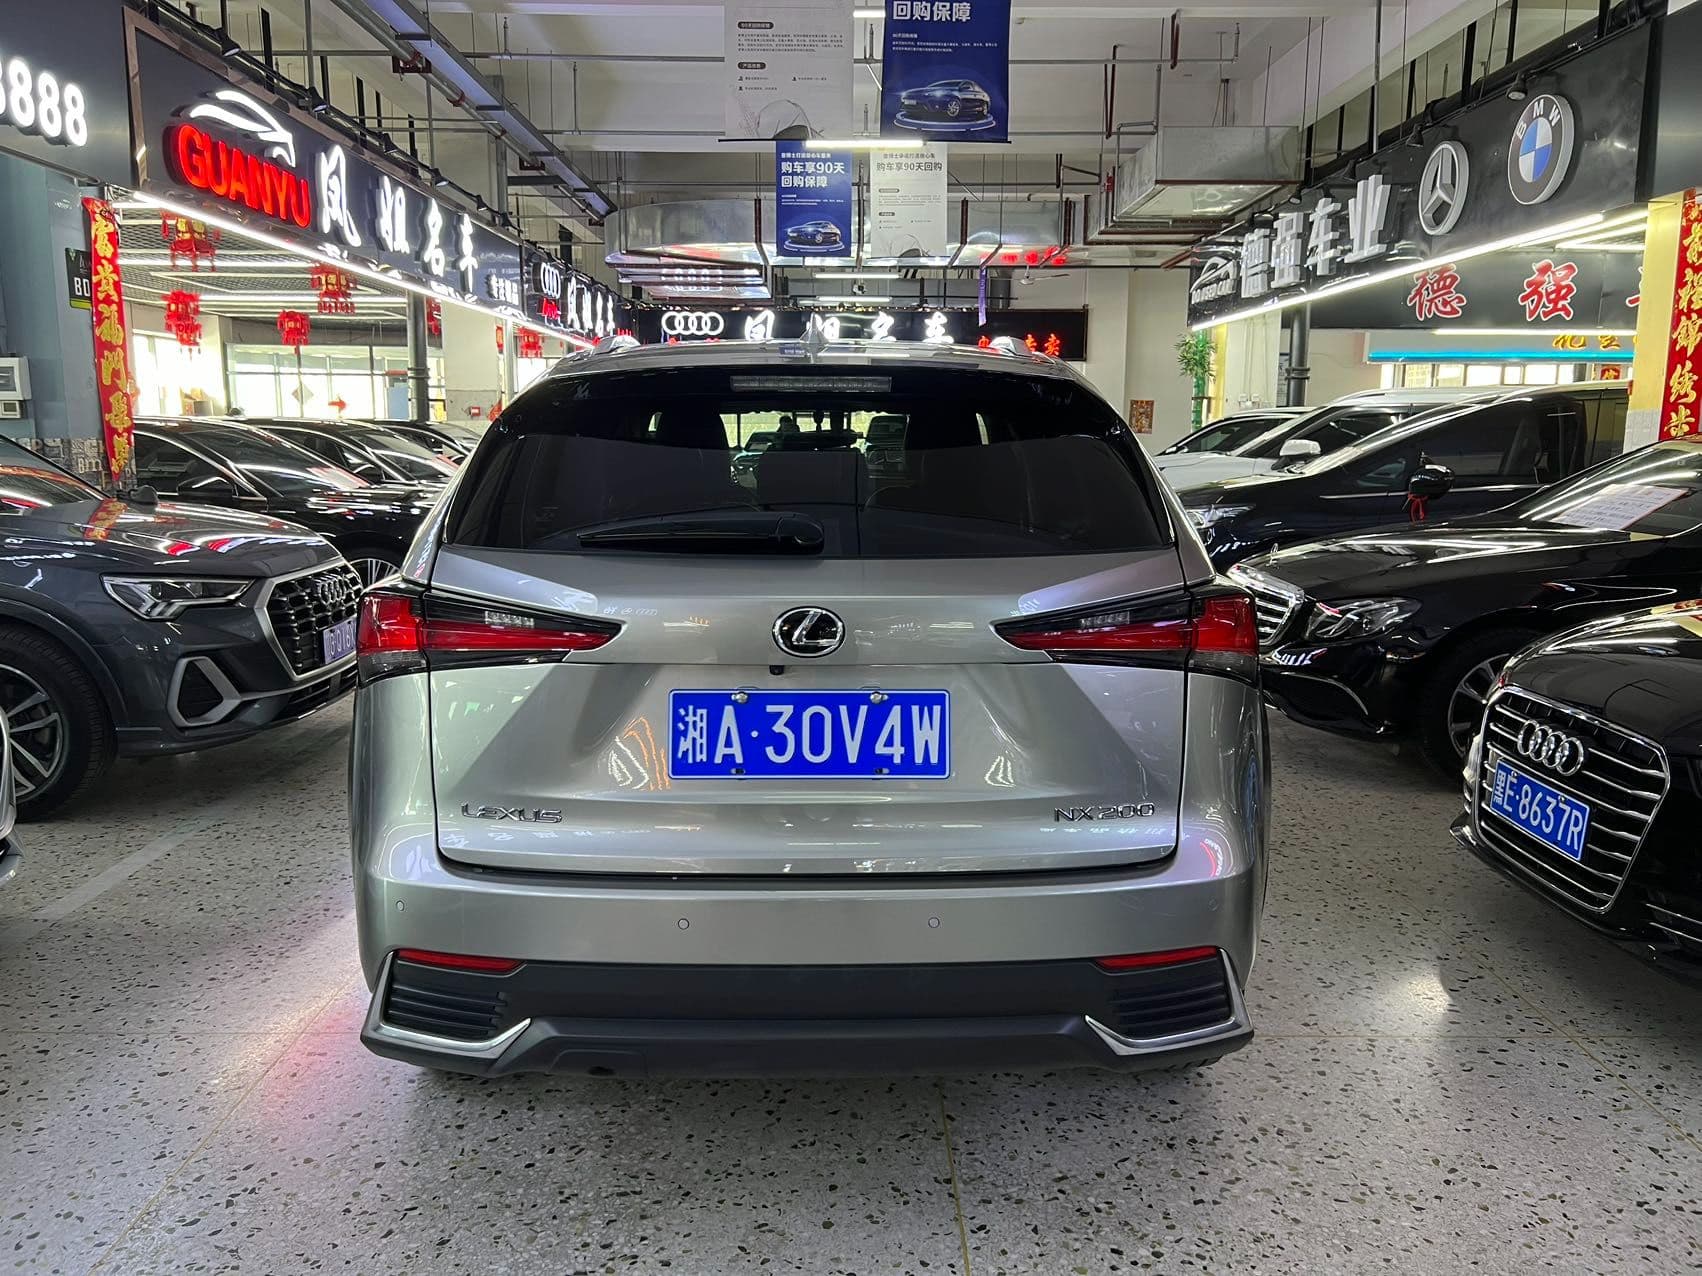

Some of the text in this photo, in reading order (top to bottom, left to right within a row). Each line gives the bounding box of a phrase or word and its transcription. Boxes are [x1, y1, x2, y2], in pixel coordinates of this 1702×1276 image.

[893, 1, 971, 22] 回购保障
[0, 56, 88, 147] 888
[1516, 99, 1561, 140] BMW
[179, 123, 312, 229] GUANYU
[781, 161, 845, 174] 购车享90天
[876, 162, 943, 172] 购车享90天回购
[781, 175, 828, 188] 回购保障
[461, 803, 562, 823] LEXUS
[1054, 802, 1155, 822] NX 200
